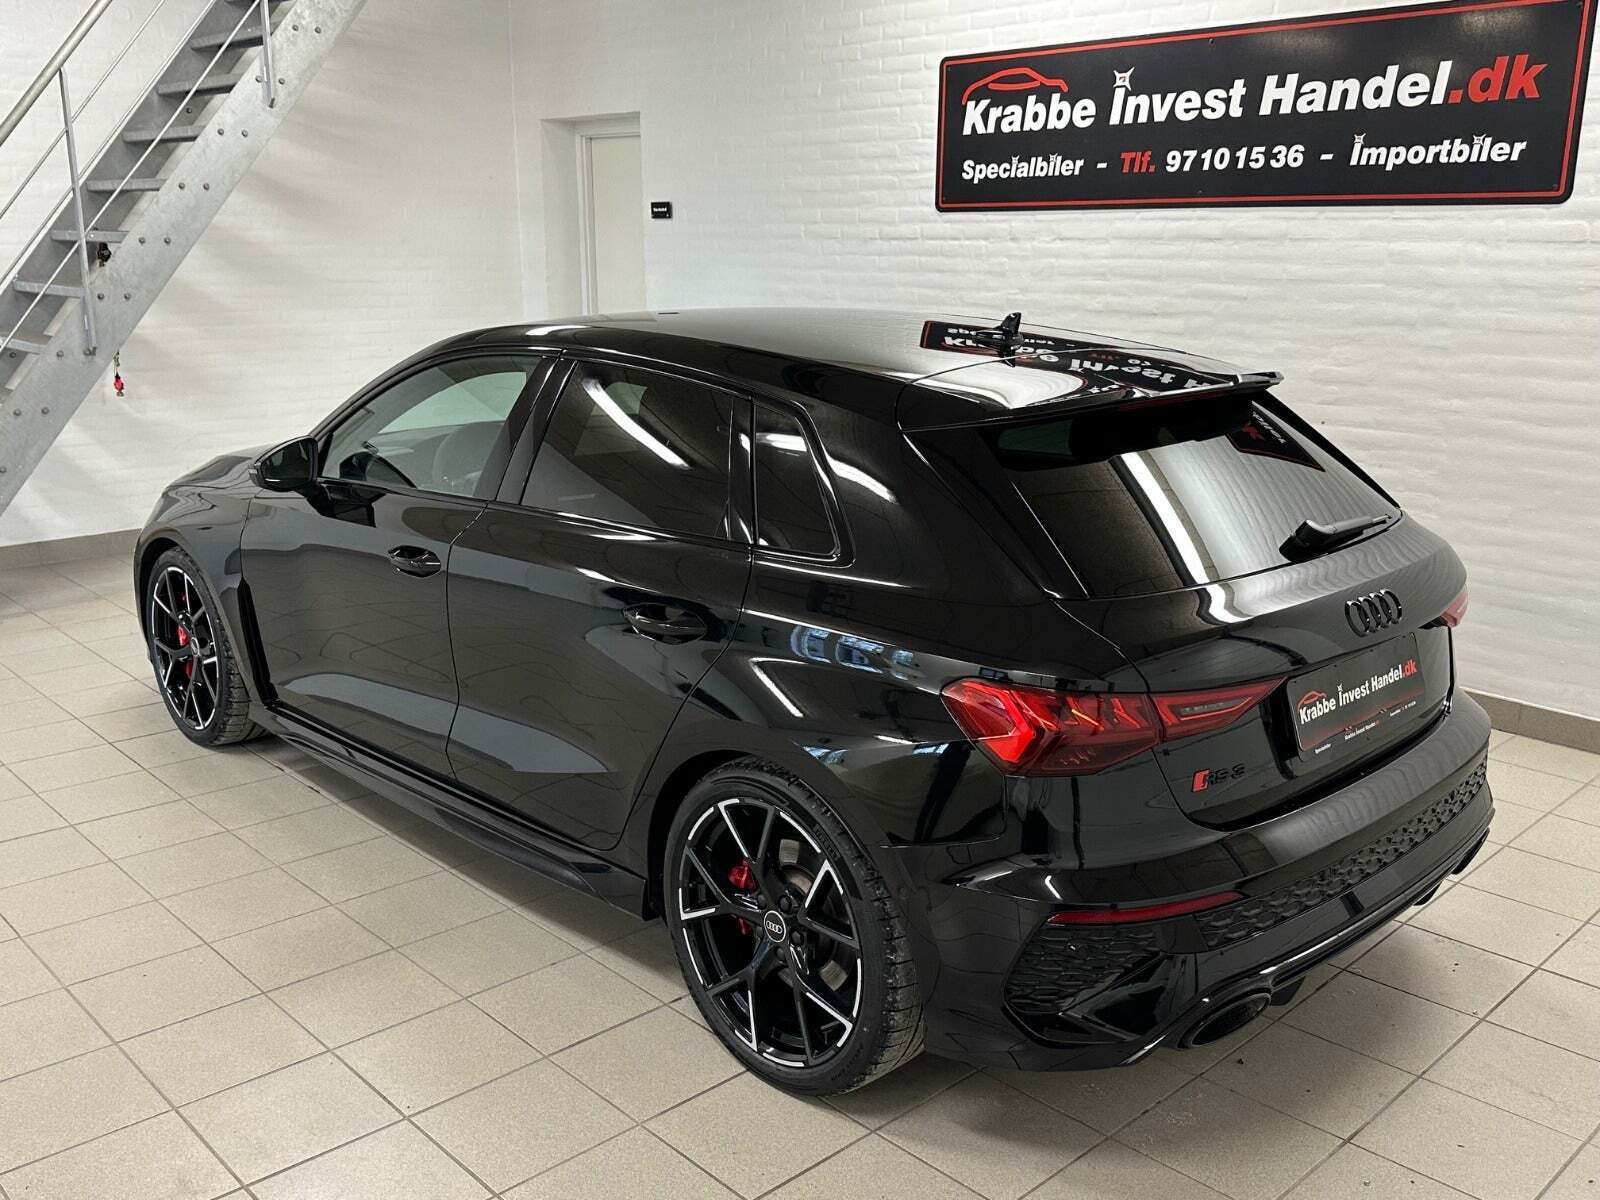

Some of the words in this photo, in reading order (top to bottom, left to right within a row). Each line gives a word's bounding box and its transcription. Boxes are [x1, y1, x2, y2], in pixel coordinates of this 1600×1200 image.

[962, 93, 1097, 136] Krabbe
[1109, 67, 1247, 126] Invest
[1258, 54, 1548, 116] Handel.dk
[961, 152, 1084, 184] Specialbiler
[1119, 151, 1156, 173] Tlf.
[1350, 132, 1528, 172] Importbiler
[1299, 698, 1337, 725] Krabbe
[1338, 680, 1371, 707] Invest
[1371, 659, 1418, 693] Handel.dk
